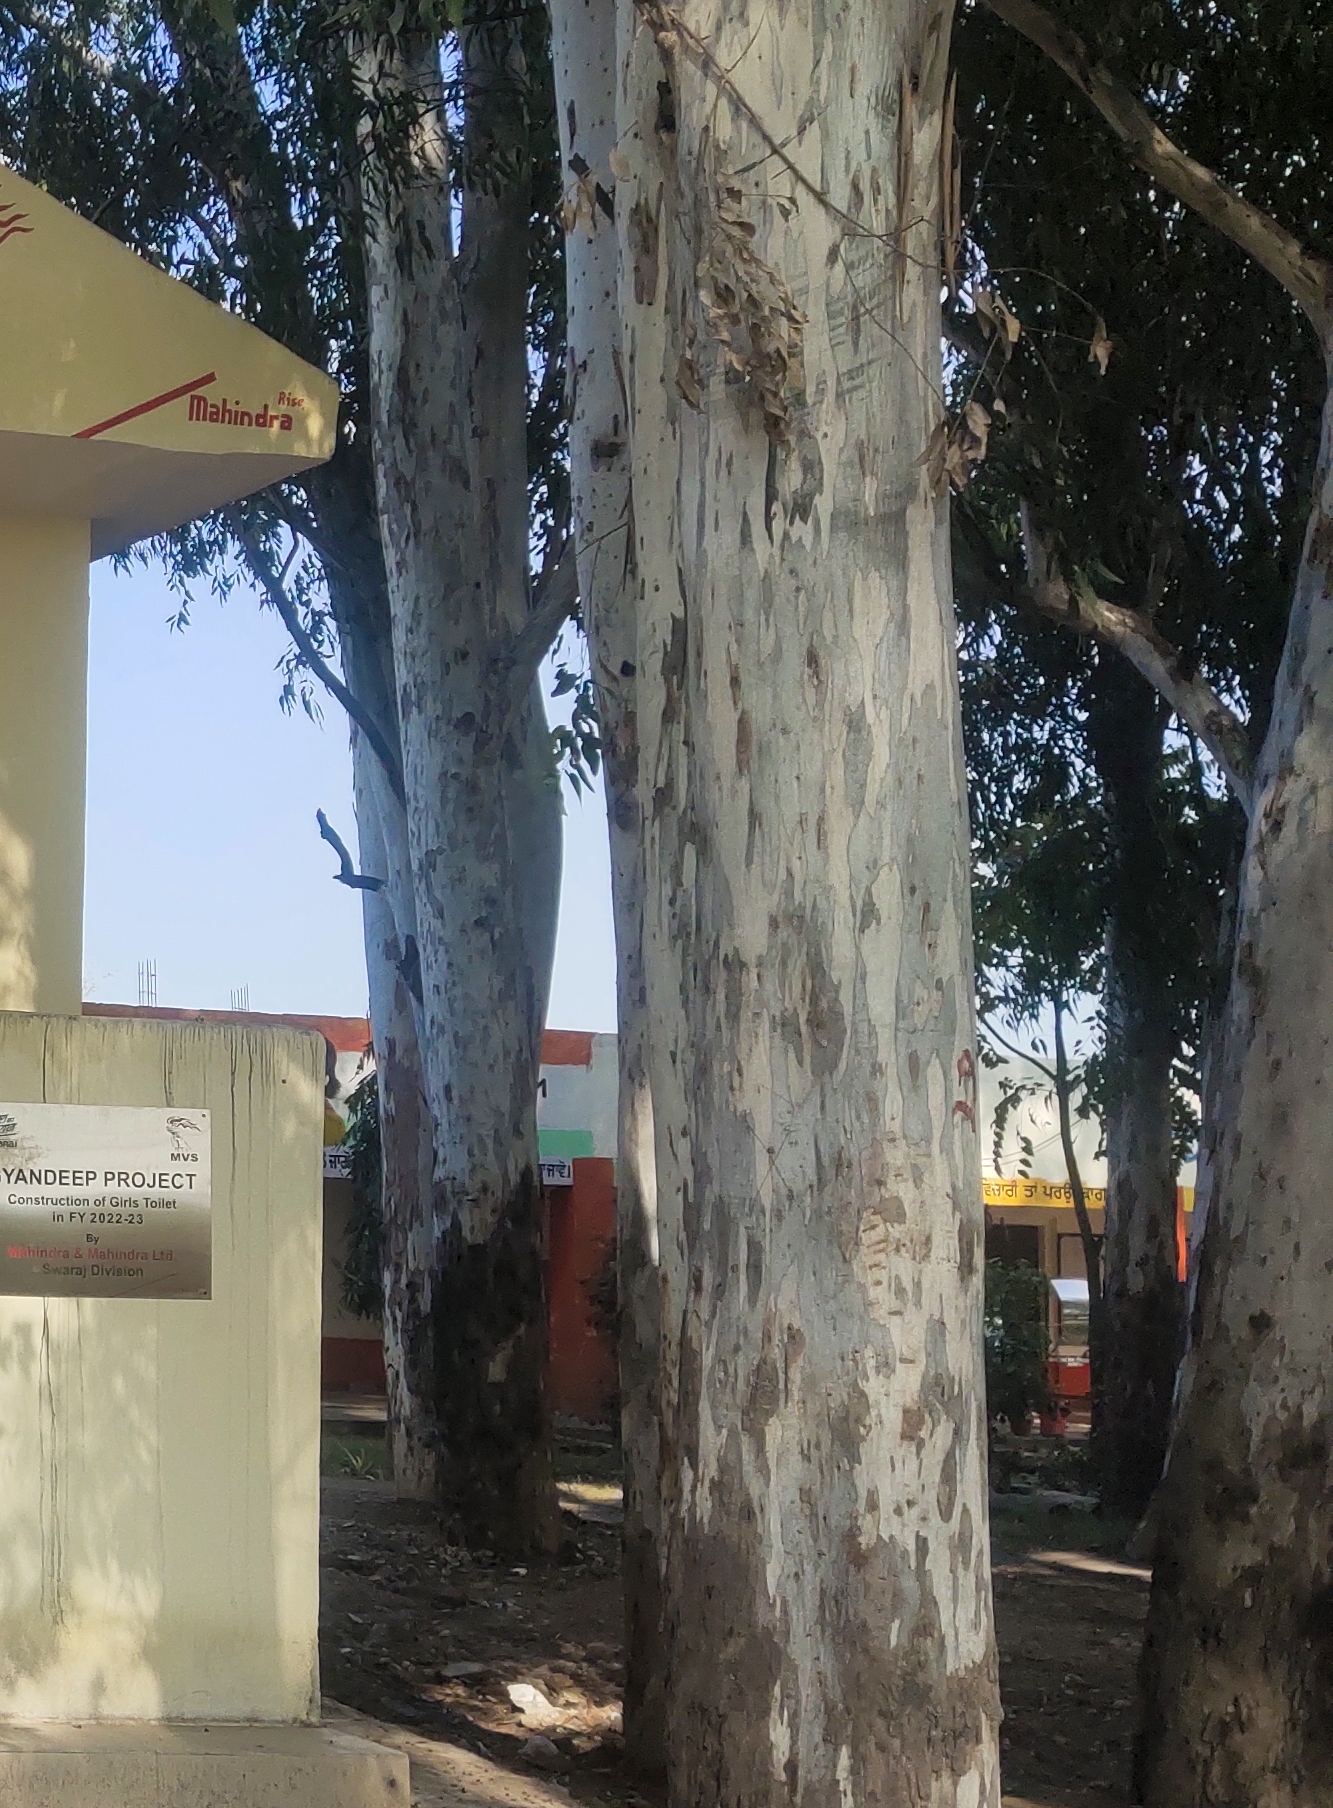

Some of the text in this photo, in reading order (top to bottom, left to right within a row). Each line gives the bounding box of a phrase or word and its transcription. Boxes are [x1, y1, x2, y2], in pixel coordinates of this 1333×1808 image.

[188, 394, 293, 431] Mahindra
[170, 1152, 200, 1163] MVS
[104, 1171, 197, 1190] PROJECT
[7, 1193, 178, 1210] Construction of Girls Toilet
[52, 1211, 144, 1225] in FY 2022-23
[85, 1233, 100, 1245] By
[74, 1248, 83, 1259] &
[87, 1248, 148, 1261] Mahindra
[152, 1250, 173, 1262] Ltd
[42, 1263, 144, 1279] Swaraj Division
